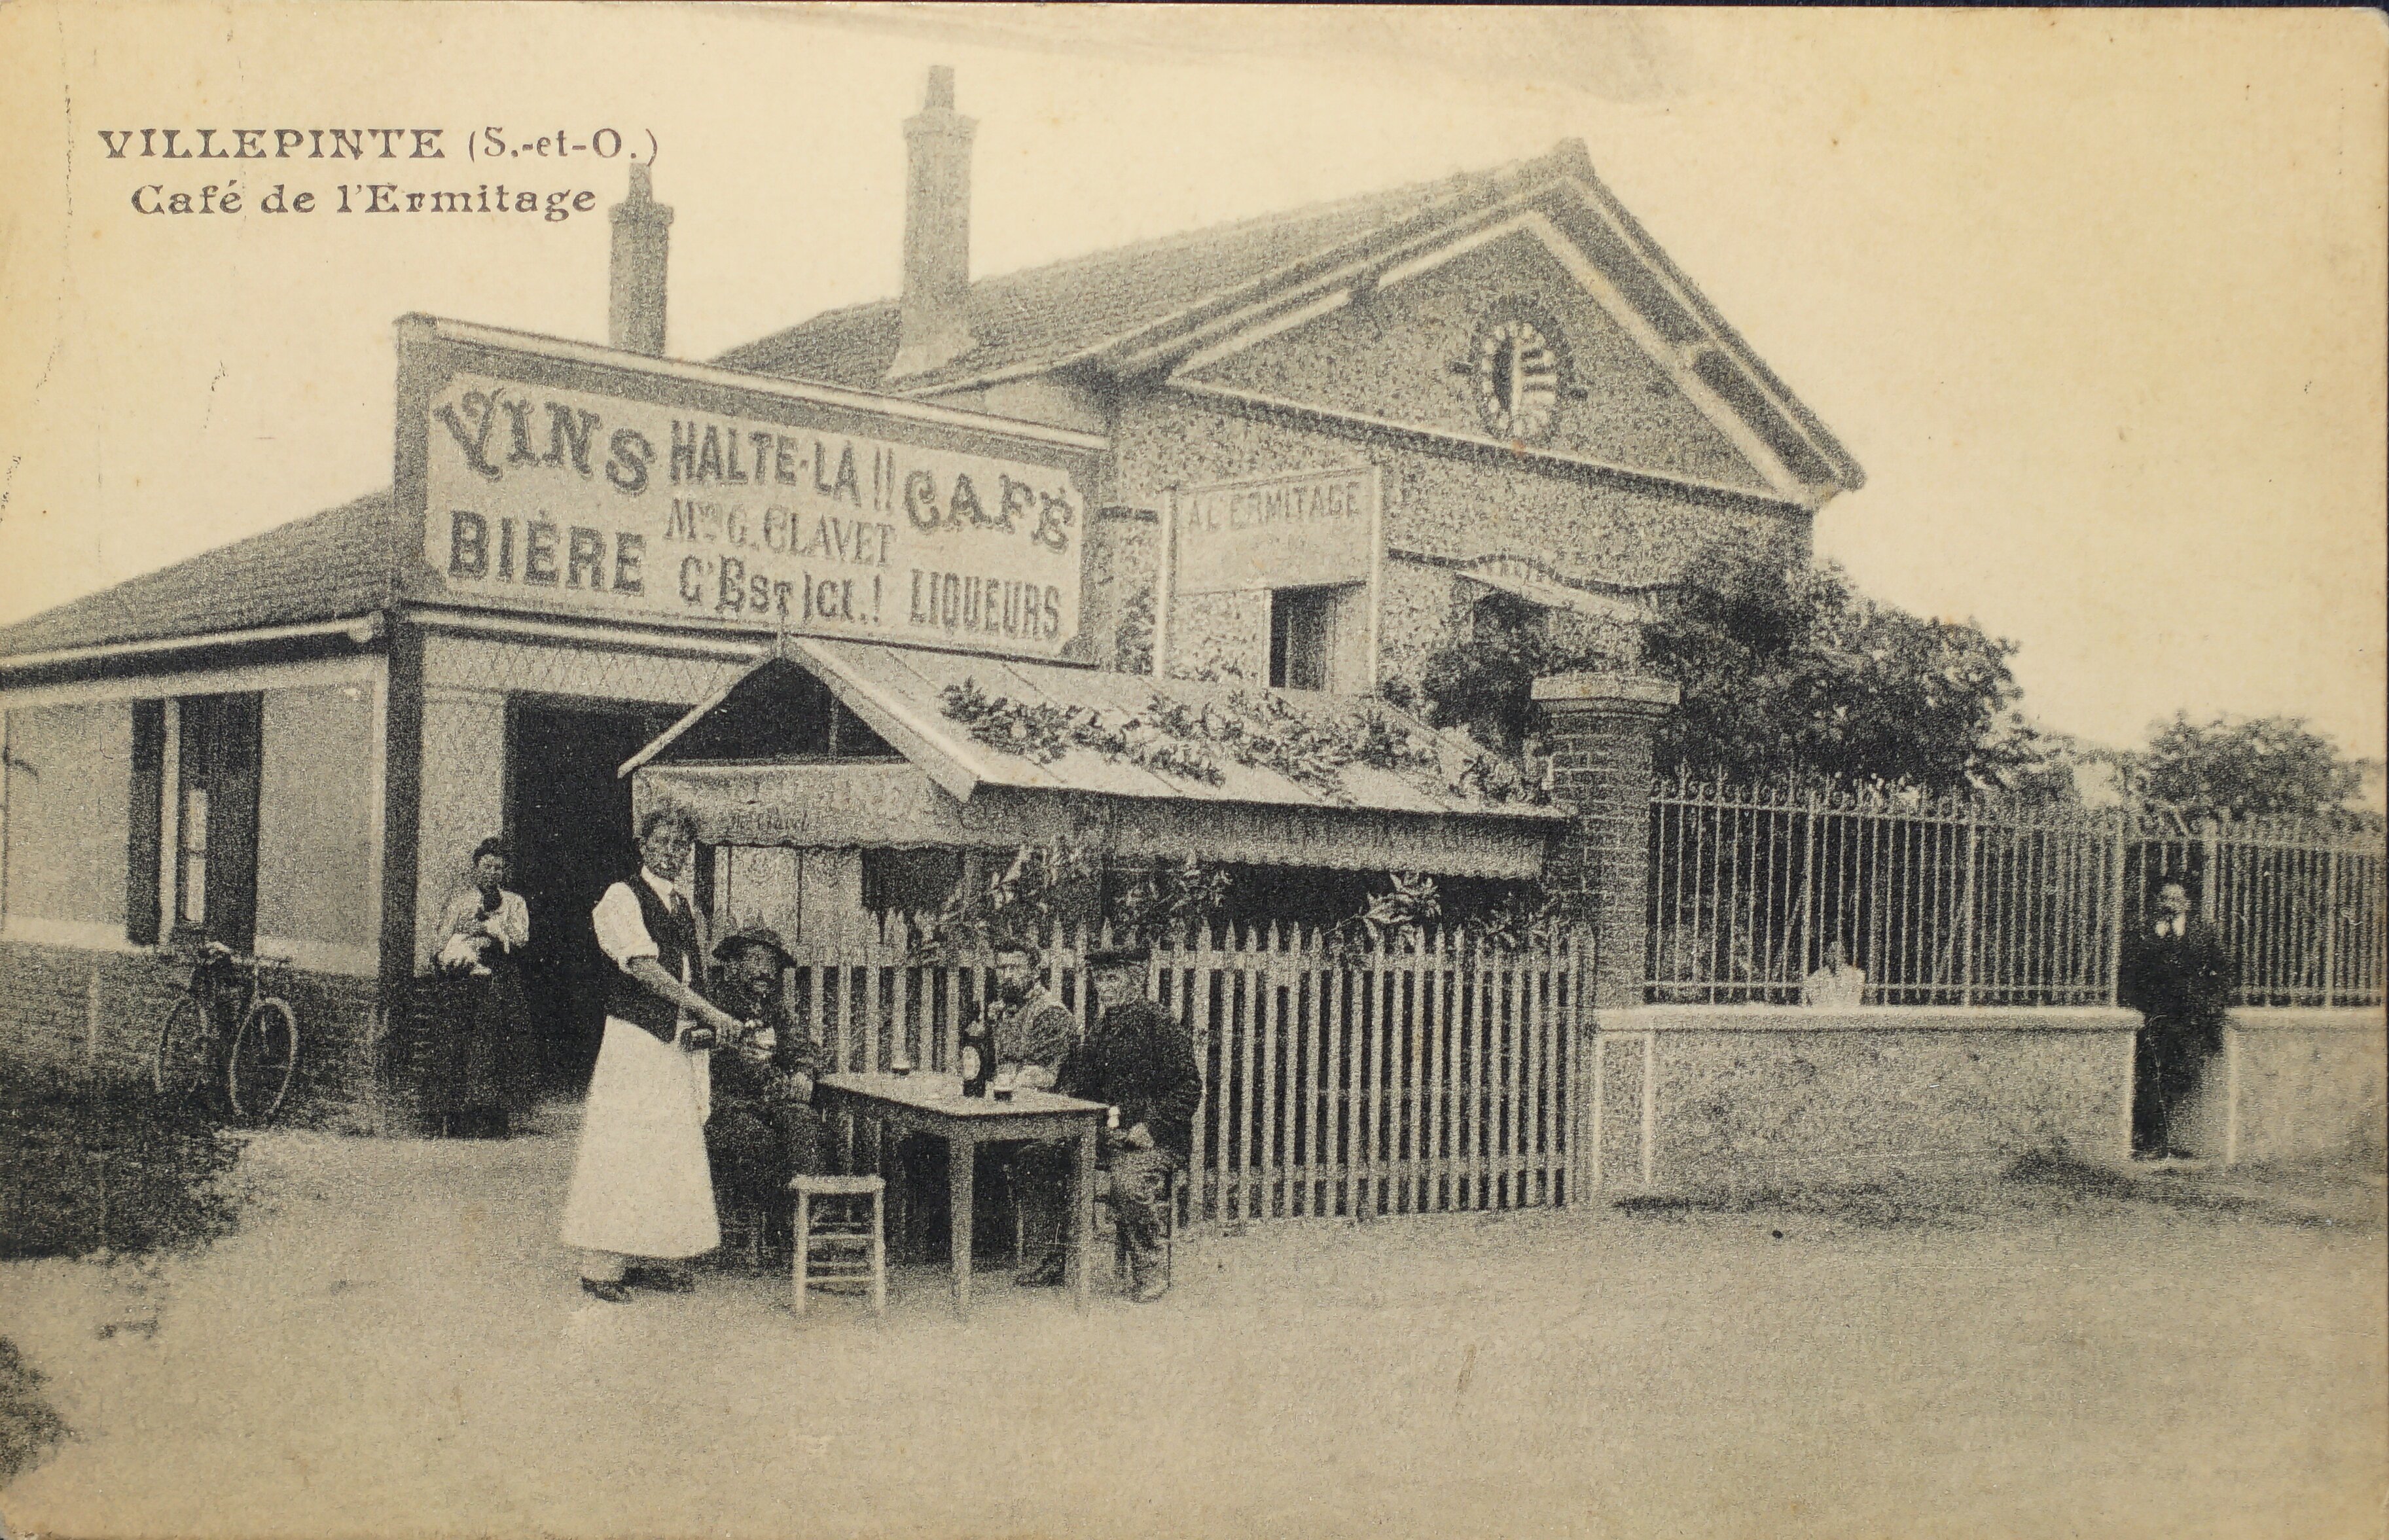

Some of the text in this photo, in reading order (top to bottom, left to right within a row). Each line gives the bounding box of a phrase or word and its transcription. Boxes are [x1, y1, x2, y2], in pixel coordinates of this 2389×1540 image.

[433, 387, 655, 496] VINS
[446, 508, 647, 597] BIÈRE
[910, 568, 1061, 641] LIQUEURS
